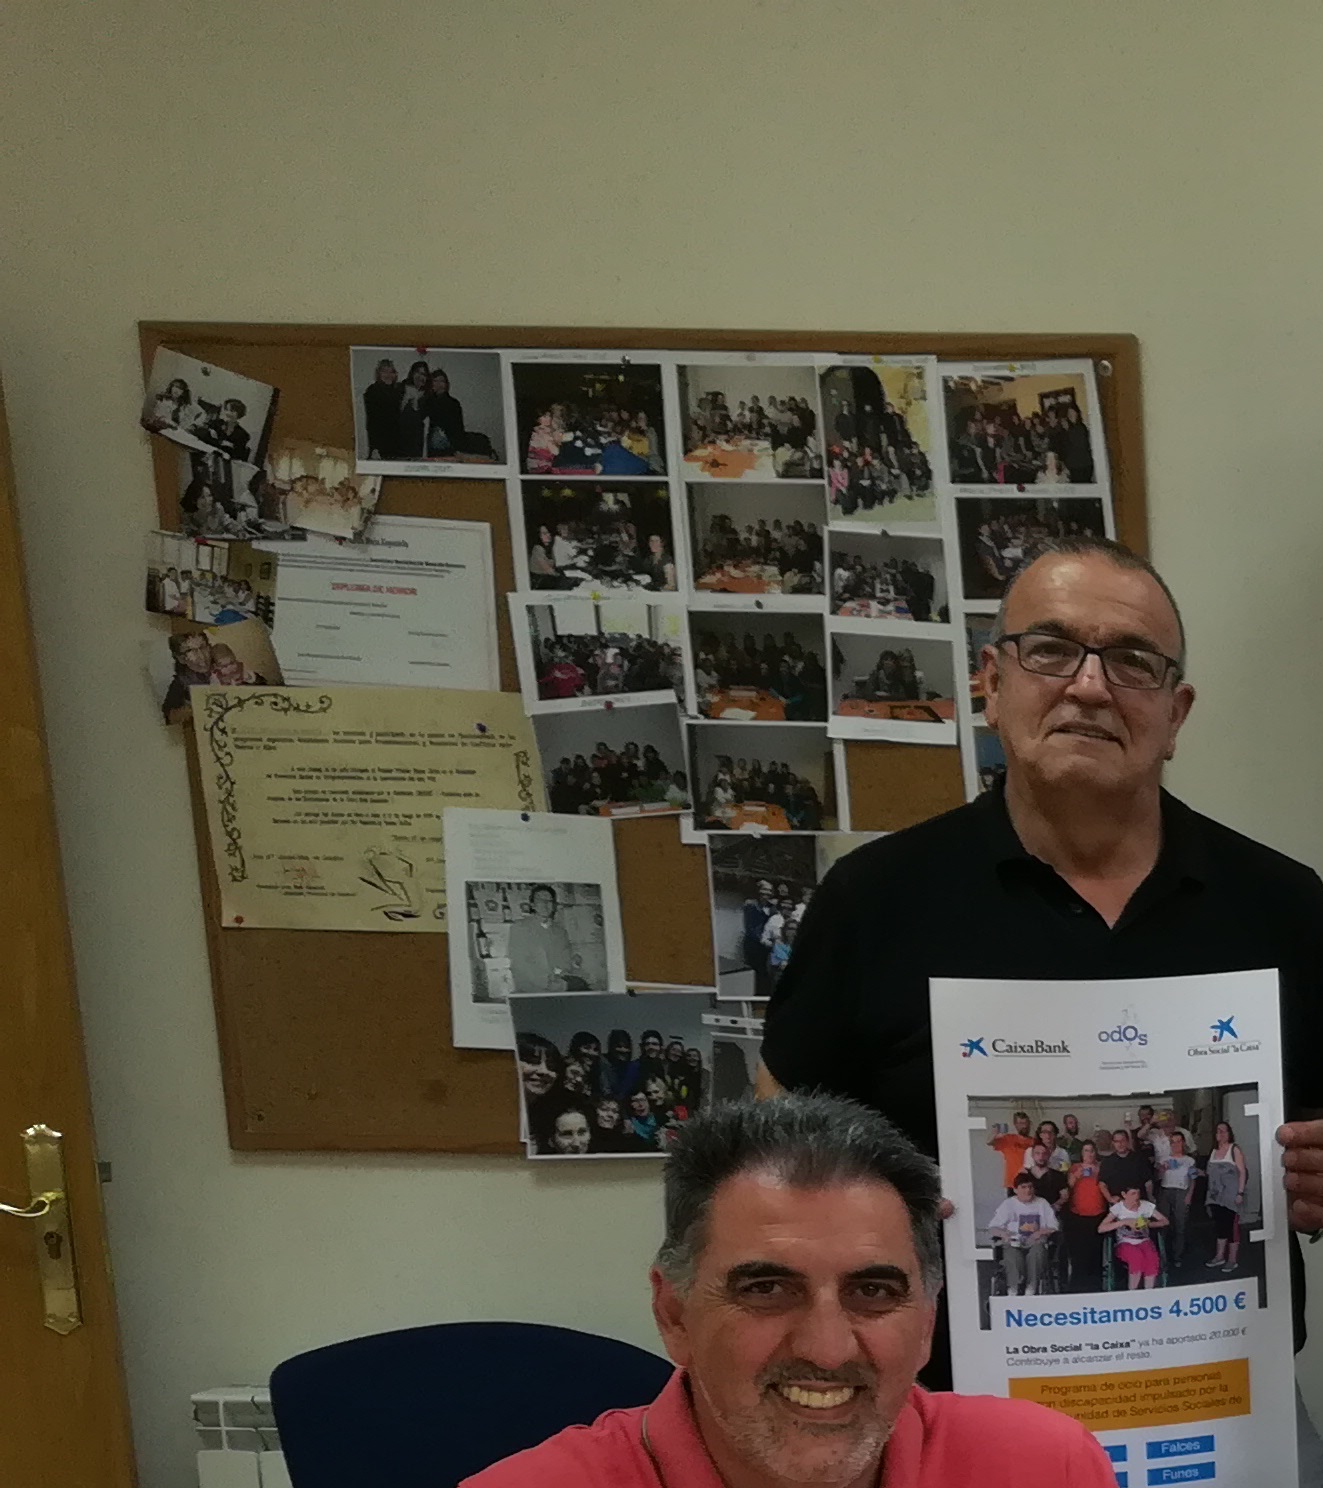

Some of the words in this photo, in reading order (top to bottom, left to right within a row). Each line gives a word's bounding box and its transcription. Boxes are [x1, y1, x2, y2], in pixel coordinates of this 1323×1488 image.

[991, 1038, 1071, 1055] CaixaBank
[1006, 1306, 1162, 1328] Necesitamos
[1168, 1296, 1227, 1316] 4.500
[1232, 1292, 1244, 1309] €
